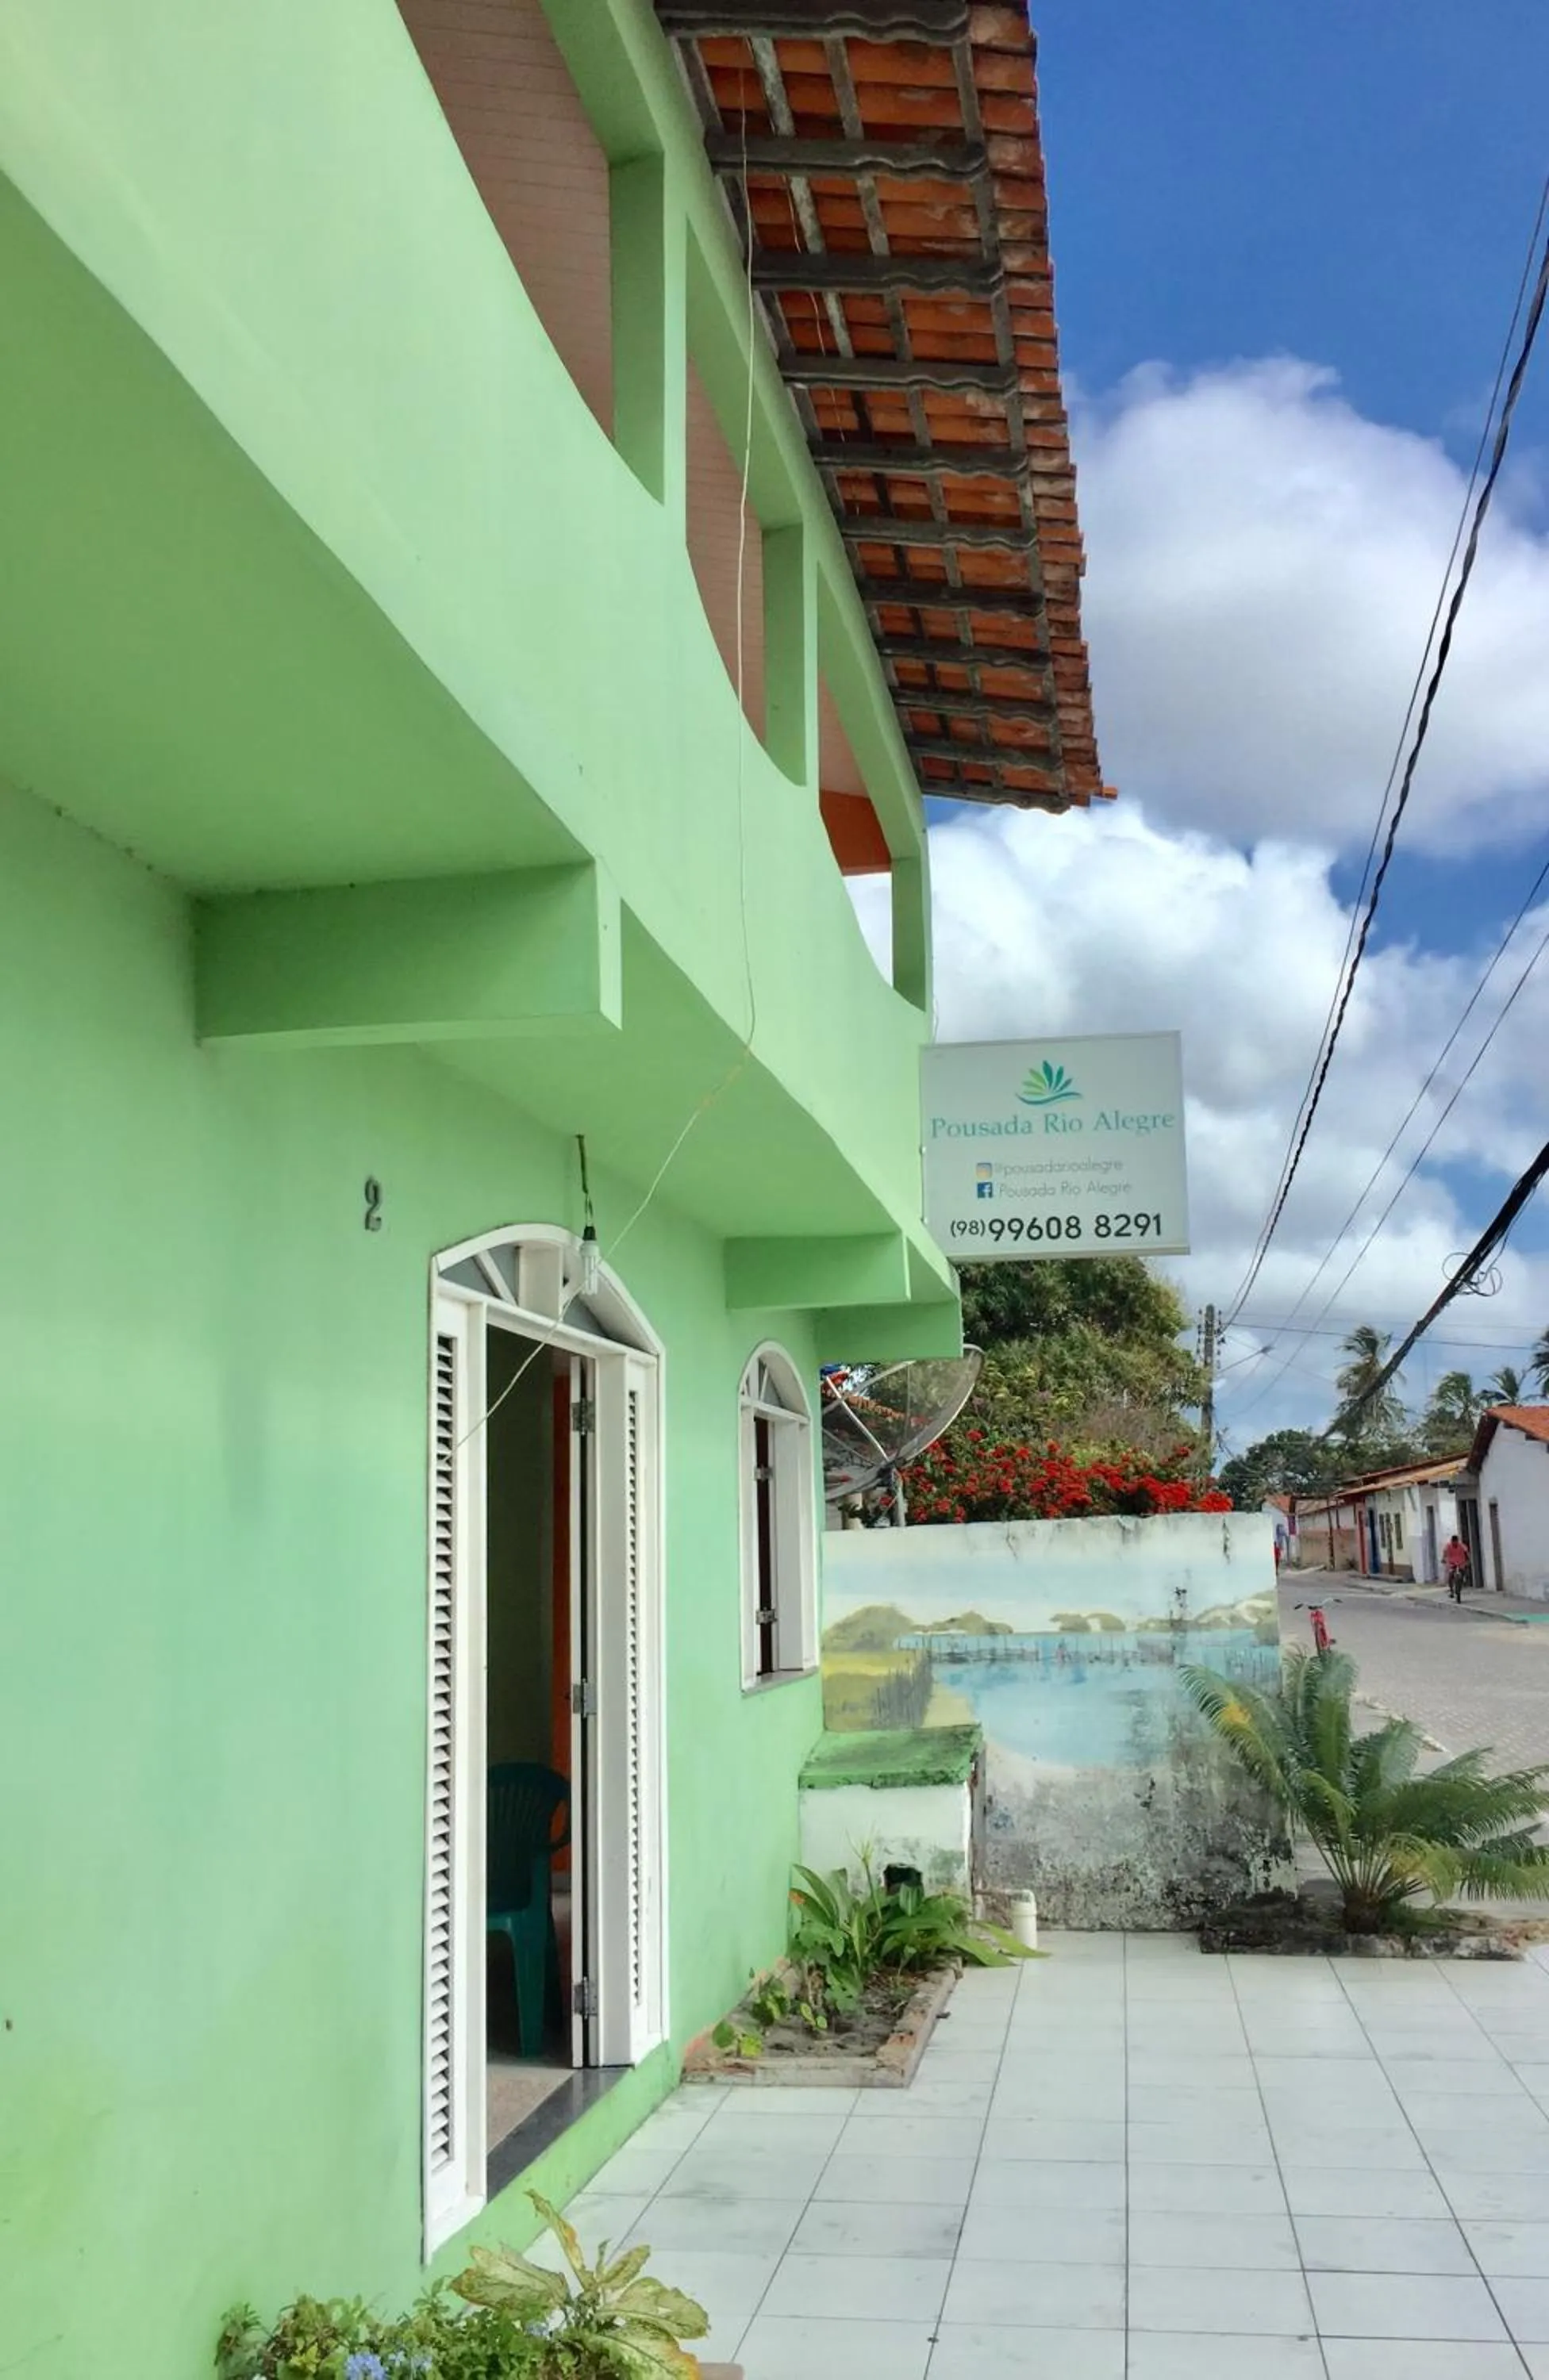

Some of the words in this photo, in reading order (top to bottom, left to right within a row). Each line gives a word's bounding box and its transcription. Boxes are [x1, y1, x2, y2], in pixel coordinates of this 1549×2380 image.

[930, 1115, 1033, 1138] Pousada
[1044, 1112, 1083, 1134] Rio
[1094, 1110, 1176, 1135] Alegre
[999, 1182, 1056, 1199] Pousada
[1060, 1179, 1082, 1196] Rio
[1094, 1212, 1162, 1238] 8291
